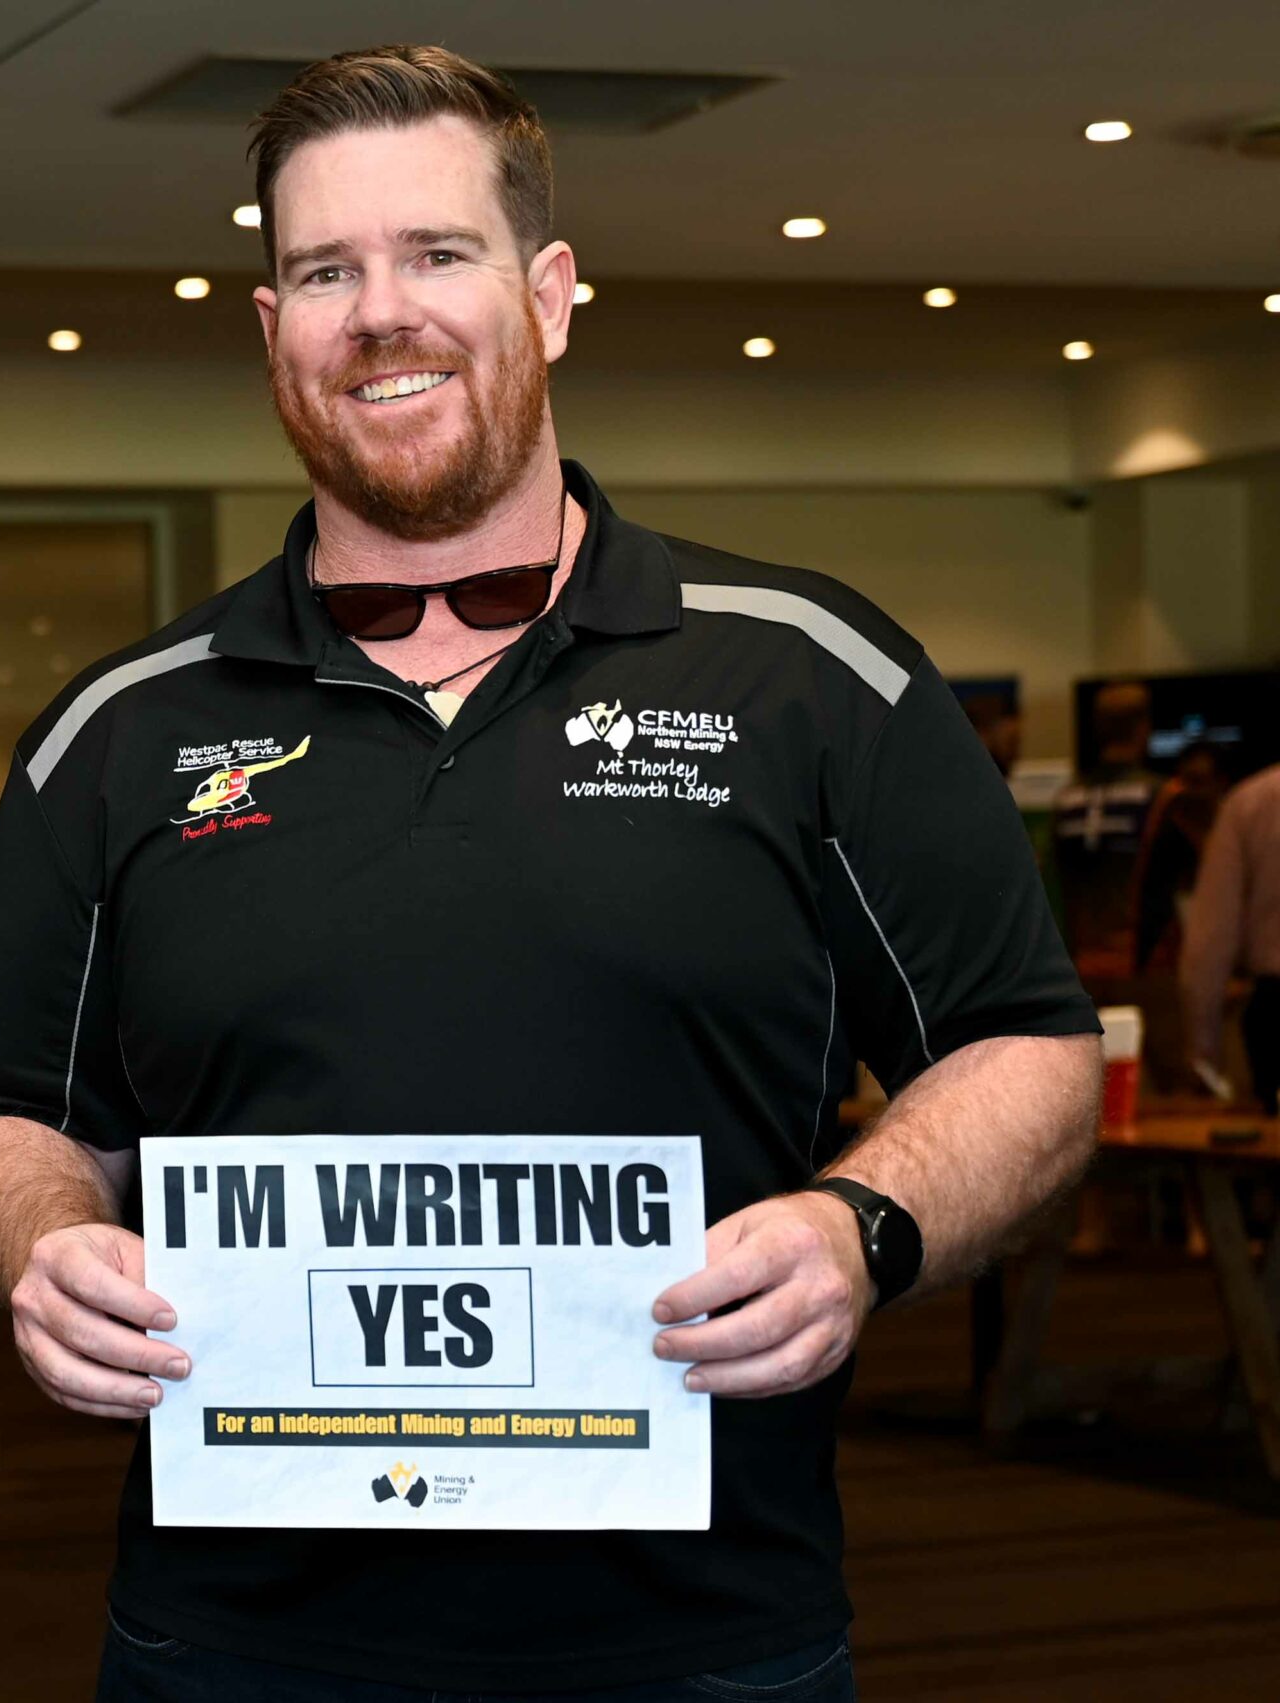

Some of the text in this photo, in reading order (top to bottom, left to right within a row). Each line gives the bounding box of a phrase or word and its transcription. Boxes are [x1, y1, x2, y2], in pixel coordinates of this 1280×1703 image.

[637, 710, 734, 731] CFMEU
[637, 725, 738, 742] Northern Mining &
[177, 745, 283, 767] Helicopter Service
[179, 737, 274, 758] Westpac Rescue
[654, 738, 724, 753] NSW Energy
[596, 758, 698, 787] Mt Thorley
[563, 779, 730, 807] Warkworth Lodge
[182, 813, 272, 840] Proudly Supporting
[163, 1162, 672, 1249] I'M WRITING
[347, 1282, 494, 1369] YES
[216, 1413, 636, 1437] For an independent Mining and Energy Union
[434, 1475, 475, 1485] Mining &
[434, 1485, 468, 1496] Energy
[433, 1496, 461, 1504] Union
